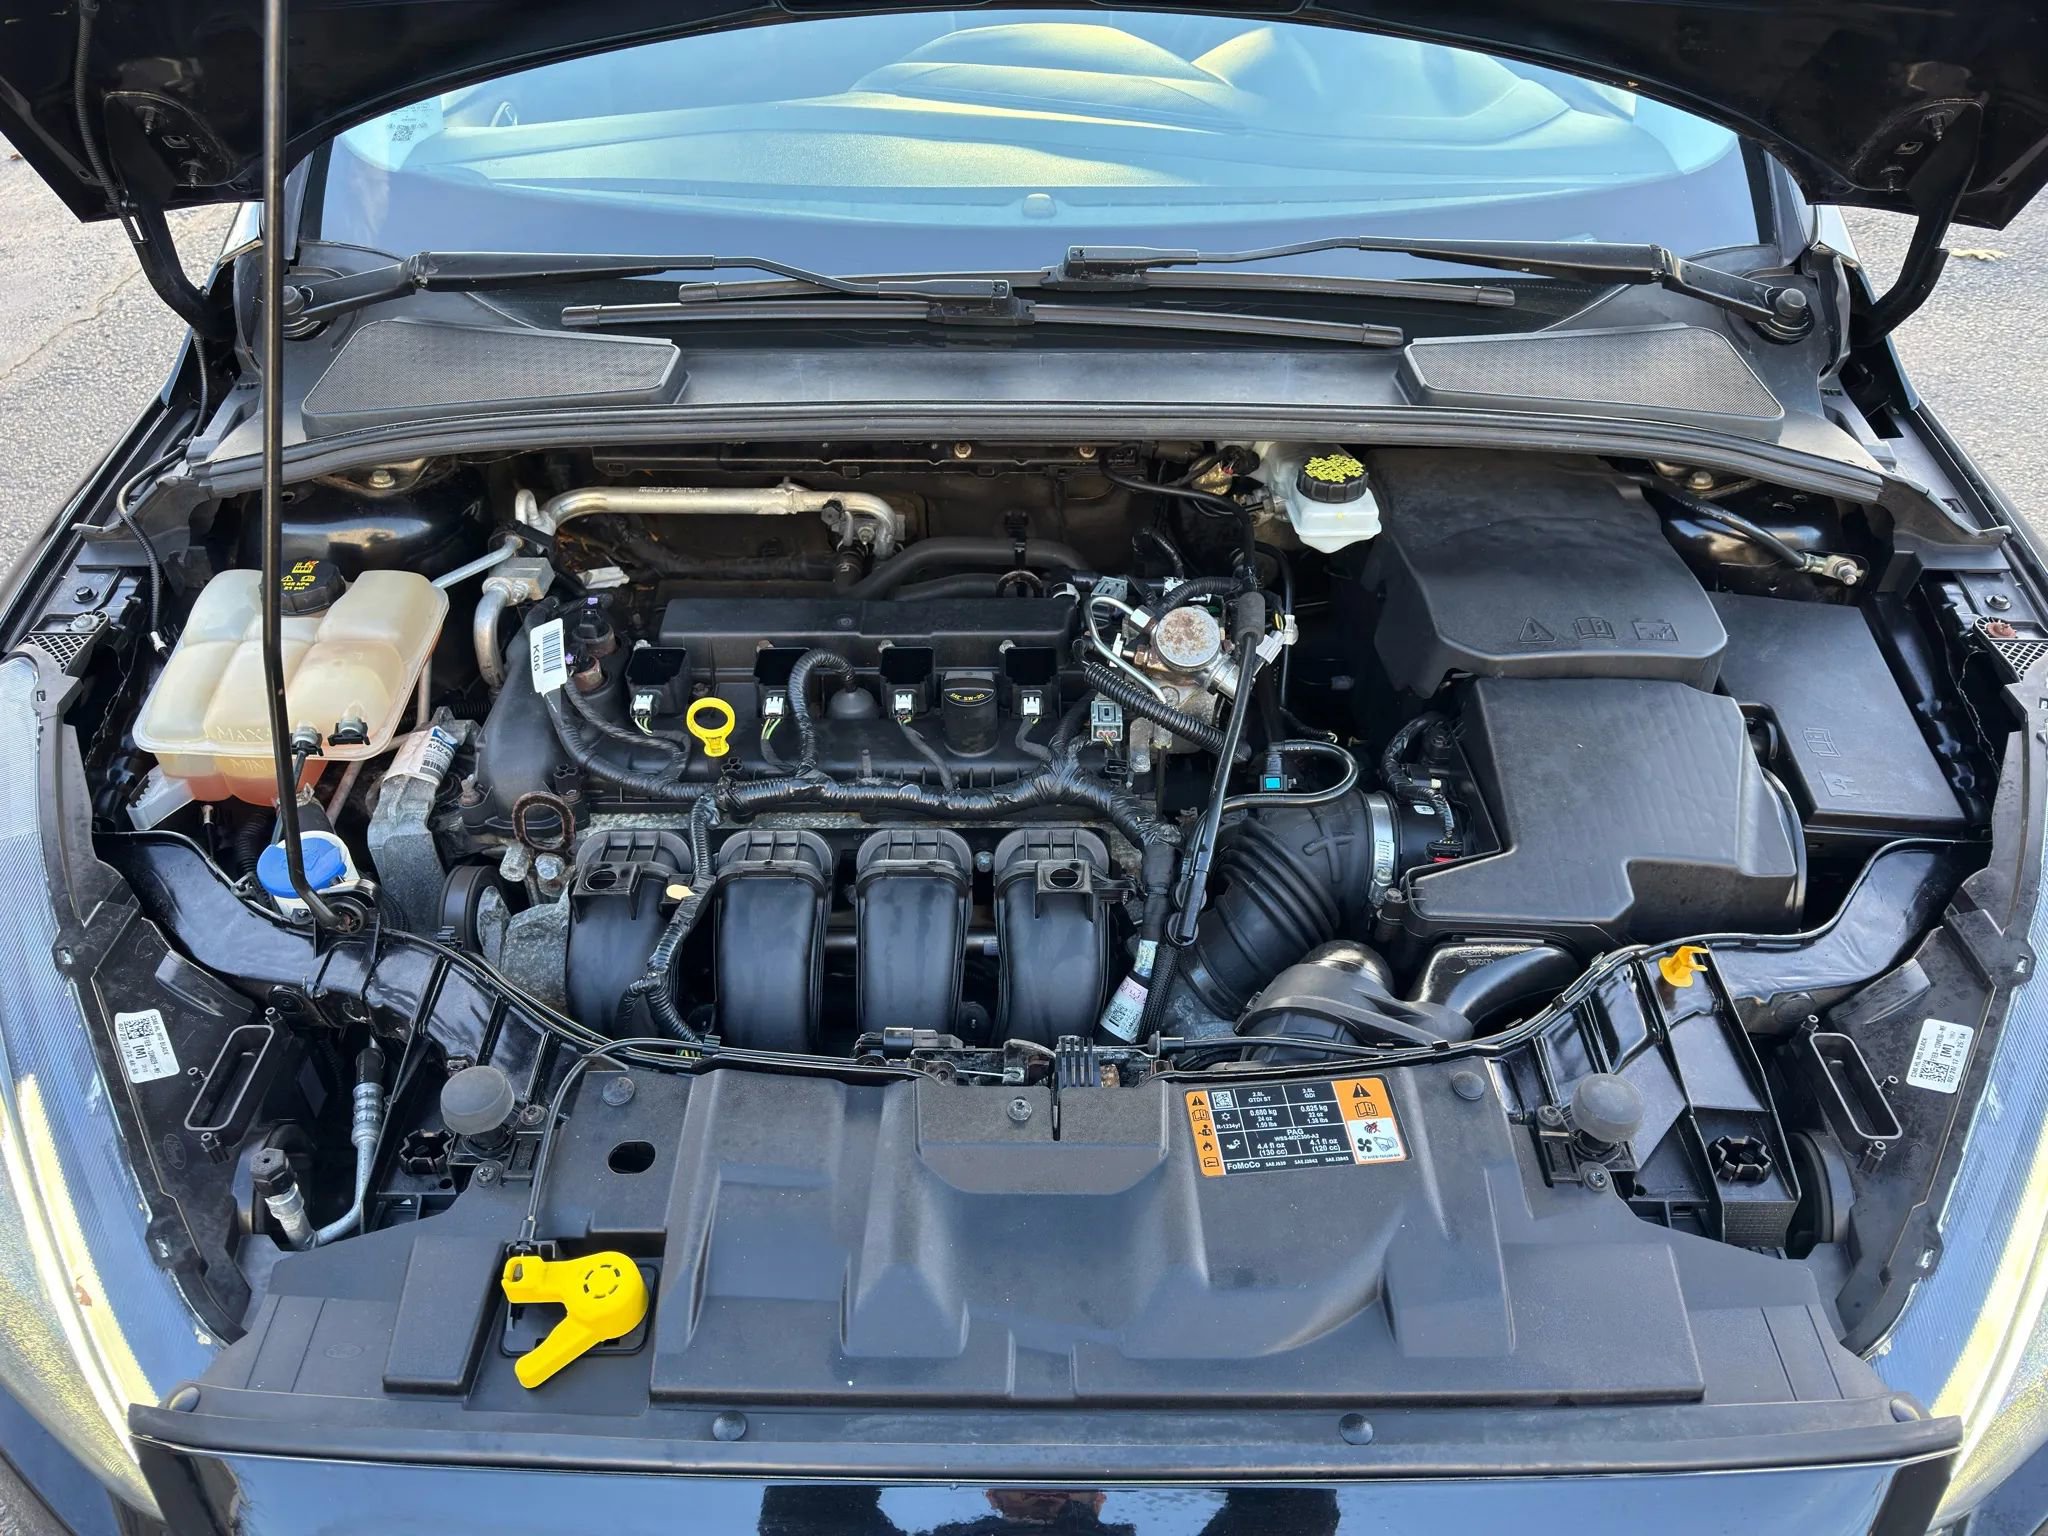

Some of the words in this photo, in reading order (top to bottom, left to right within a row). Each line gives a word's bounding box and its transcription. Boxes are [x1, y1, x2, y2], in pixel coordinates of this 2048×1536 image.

[217, 726, 265, 742] MAX
[1268, 1108, 1278, 1116] kg
[1319, 1104, 1328, 1112] kg
[1286, 1128, 1304, 1136] PAG
[1258, 1149, 1275, 1158] (130
[1275, 1148, 1288, 1156] cc)
[1311, 1145, 1328, 1153] (120
[1328, 1144, 1341, 1152] cc)
[1226, 1161, 1261, 1170] FoMoCo
